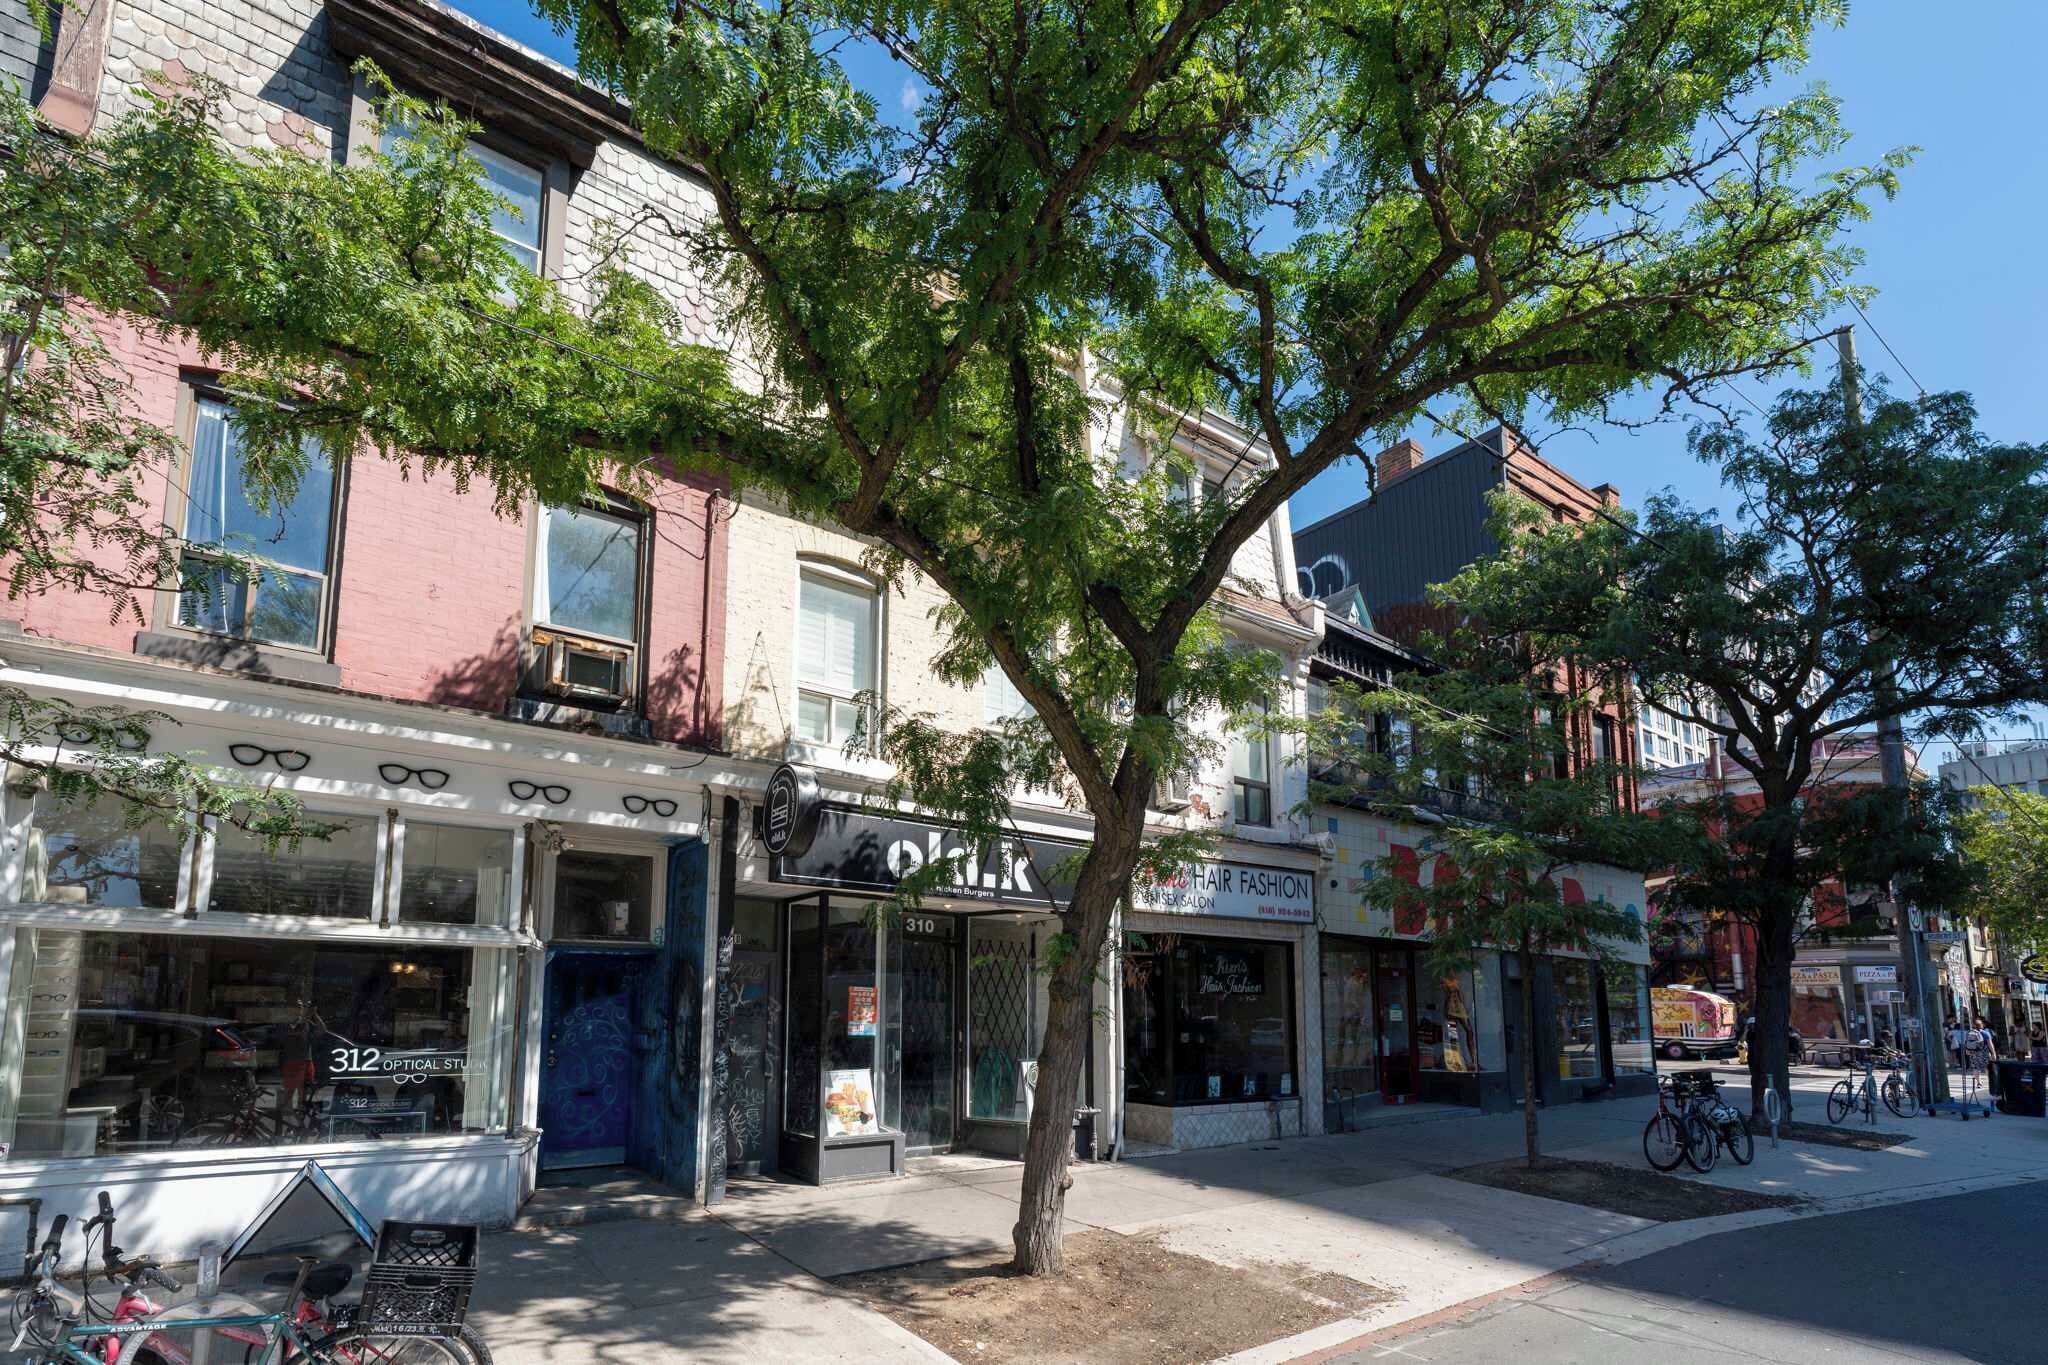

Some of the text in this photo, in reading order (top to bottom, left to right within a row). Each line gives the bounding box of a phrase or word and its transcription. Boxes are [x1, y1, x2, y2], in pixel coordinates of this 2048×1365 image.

[1193, 864, 1233, 894] HAIR
[1240, 870, 1308, 899] FASHION
[930, 884, 995, 899] hicken Burgers
[1181, 895, 1215, 910] SALON
[906, 917, 935, 934] 310
[1813, 971, 1840, 979] PASTA
[1859, 970, 1880, 978] PIZZA
[328, 1047, 381, 1073] 312
[383, 1058, 440, 1071] OPTICAL
[110, 1323, 168, 1334] ADVANTAGE
